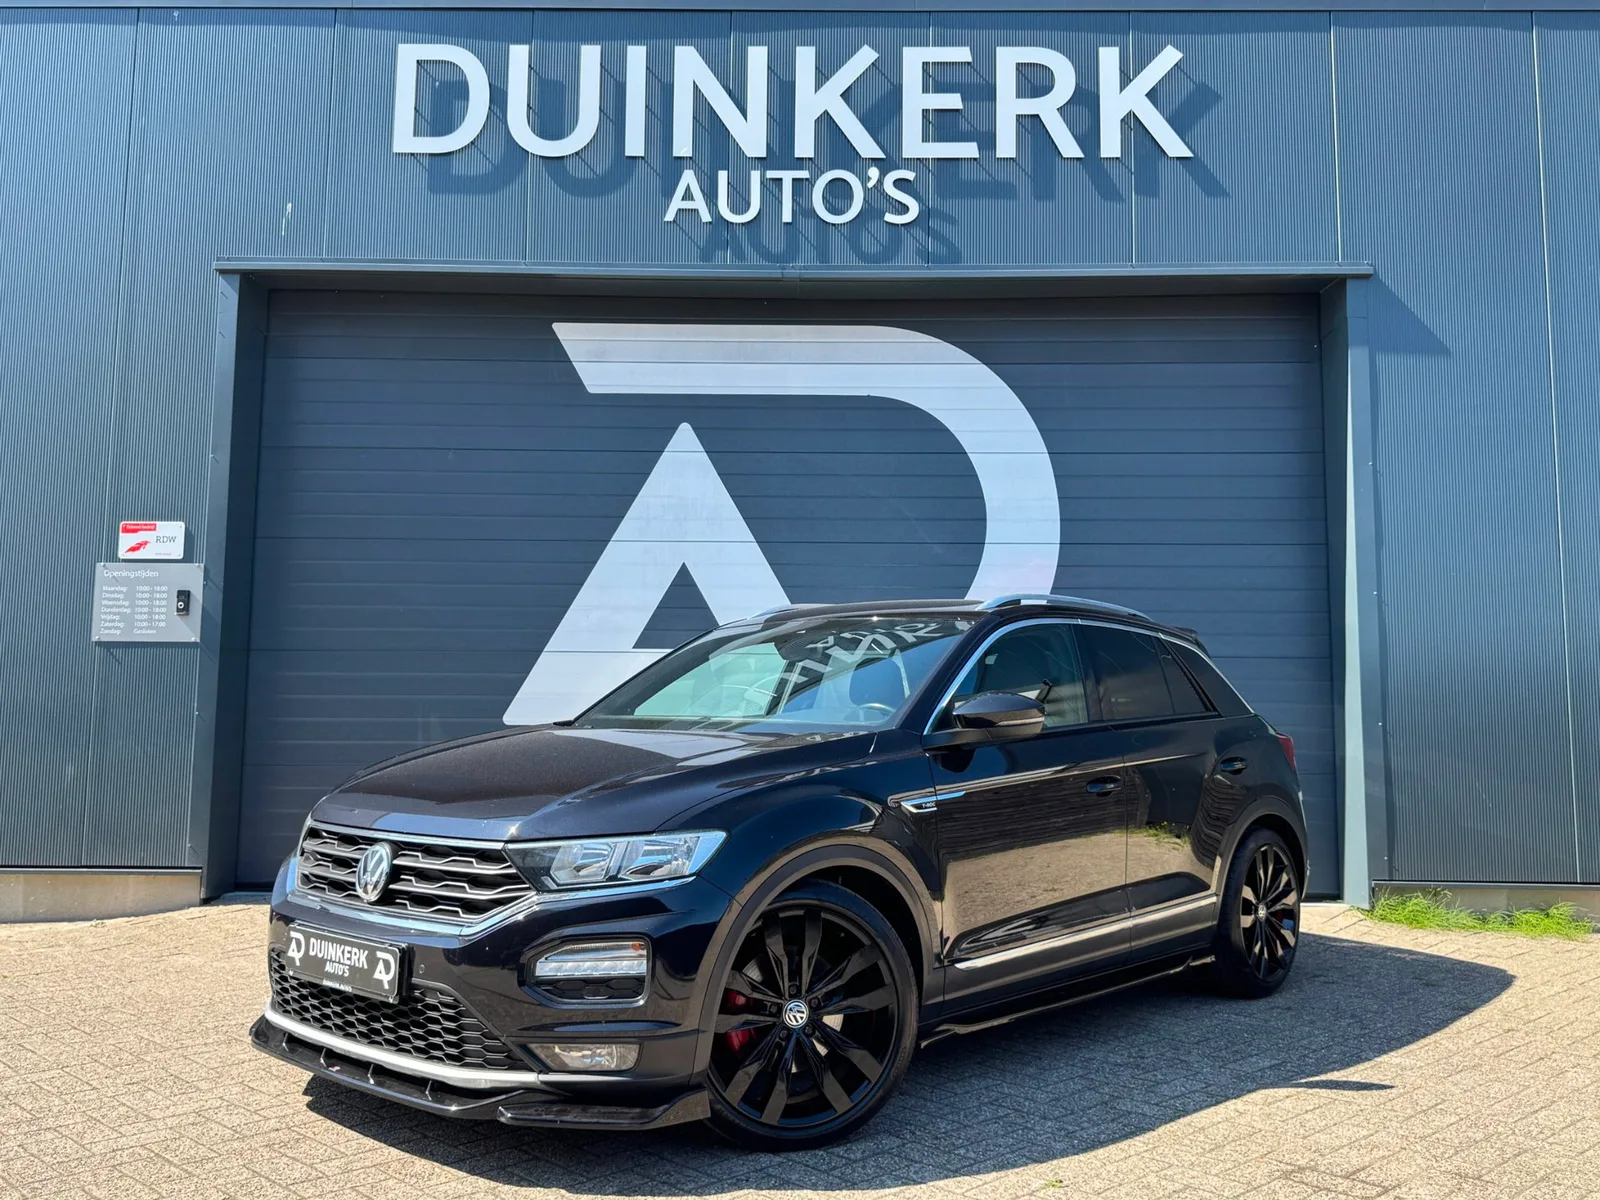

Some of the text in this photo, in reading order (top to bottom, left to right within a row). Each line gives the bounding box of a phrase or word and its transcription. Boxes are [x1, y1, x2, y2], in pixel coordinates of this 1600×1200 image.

[393, 43, 1194, 158] DUINKERK
[664, 167, 919, 225] AUTO'S
[155, 535, 177, 544] RDW
[103, 570, 159, 578] Openingstijden
[309, 938, 368, 969] DUINKERK
[324, 961, 350, 977] AUTO'S
